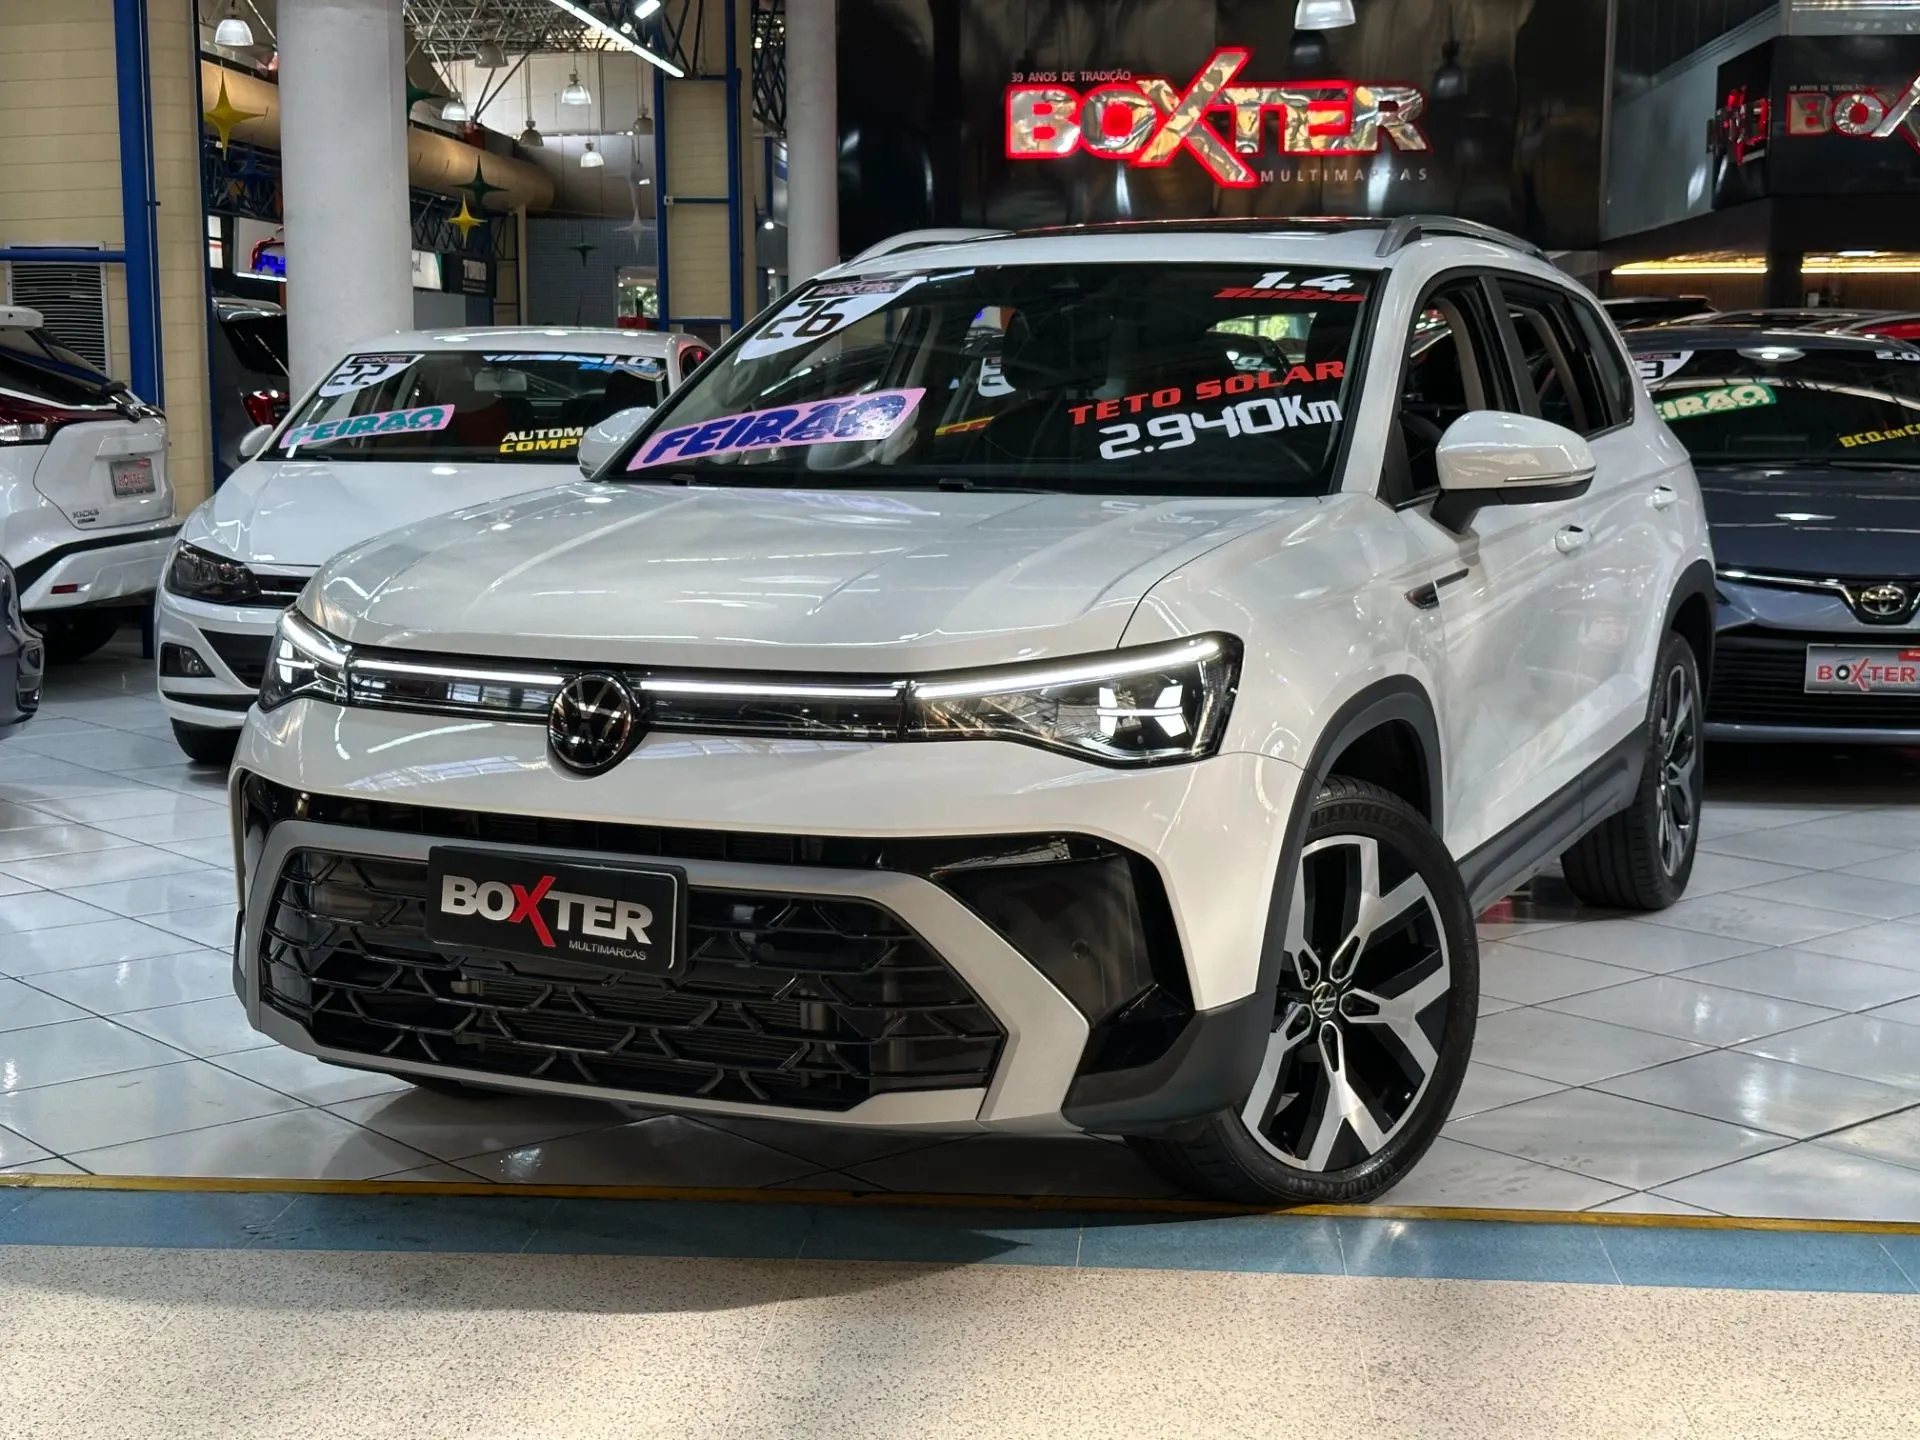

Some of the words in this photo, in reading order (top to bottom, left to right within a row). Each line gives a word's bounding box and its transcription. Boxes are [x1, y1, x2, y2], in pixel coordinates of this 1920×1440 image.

[1011, 72, 1023, 82] 39
[1028, 72, 1057, 82] ANOS
[1061, 72, 1075, 82] DE
[1080, 68, 1131, 83] TRADIÇÃO
[1006, 46, 1434, 188] BOXTER
[1786, 71, 1920, 157] BOX
[1260, 168, 1428, 182] MULTIMARAS
[1252, 271, 1355, 292] 1.4
[755, 297, 856, 340] 26
[326, 364, 389, 387] 22
[1640, 360, 1665, 380] 3
[1068, 387, 1181, 426] TETO
[1196, 360, 1345, 401] SOLAR
[499, 438, 583, 453] COMP
[502, 427, 584, 442] AUTOM
[1816, 656, 1916, 692] BOXTER
[440, 875, 654, 948] BOXTER
[568, 940, 647, 961] MULTIMARCAS
